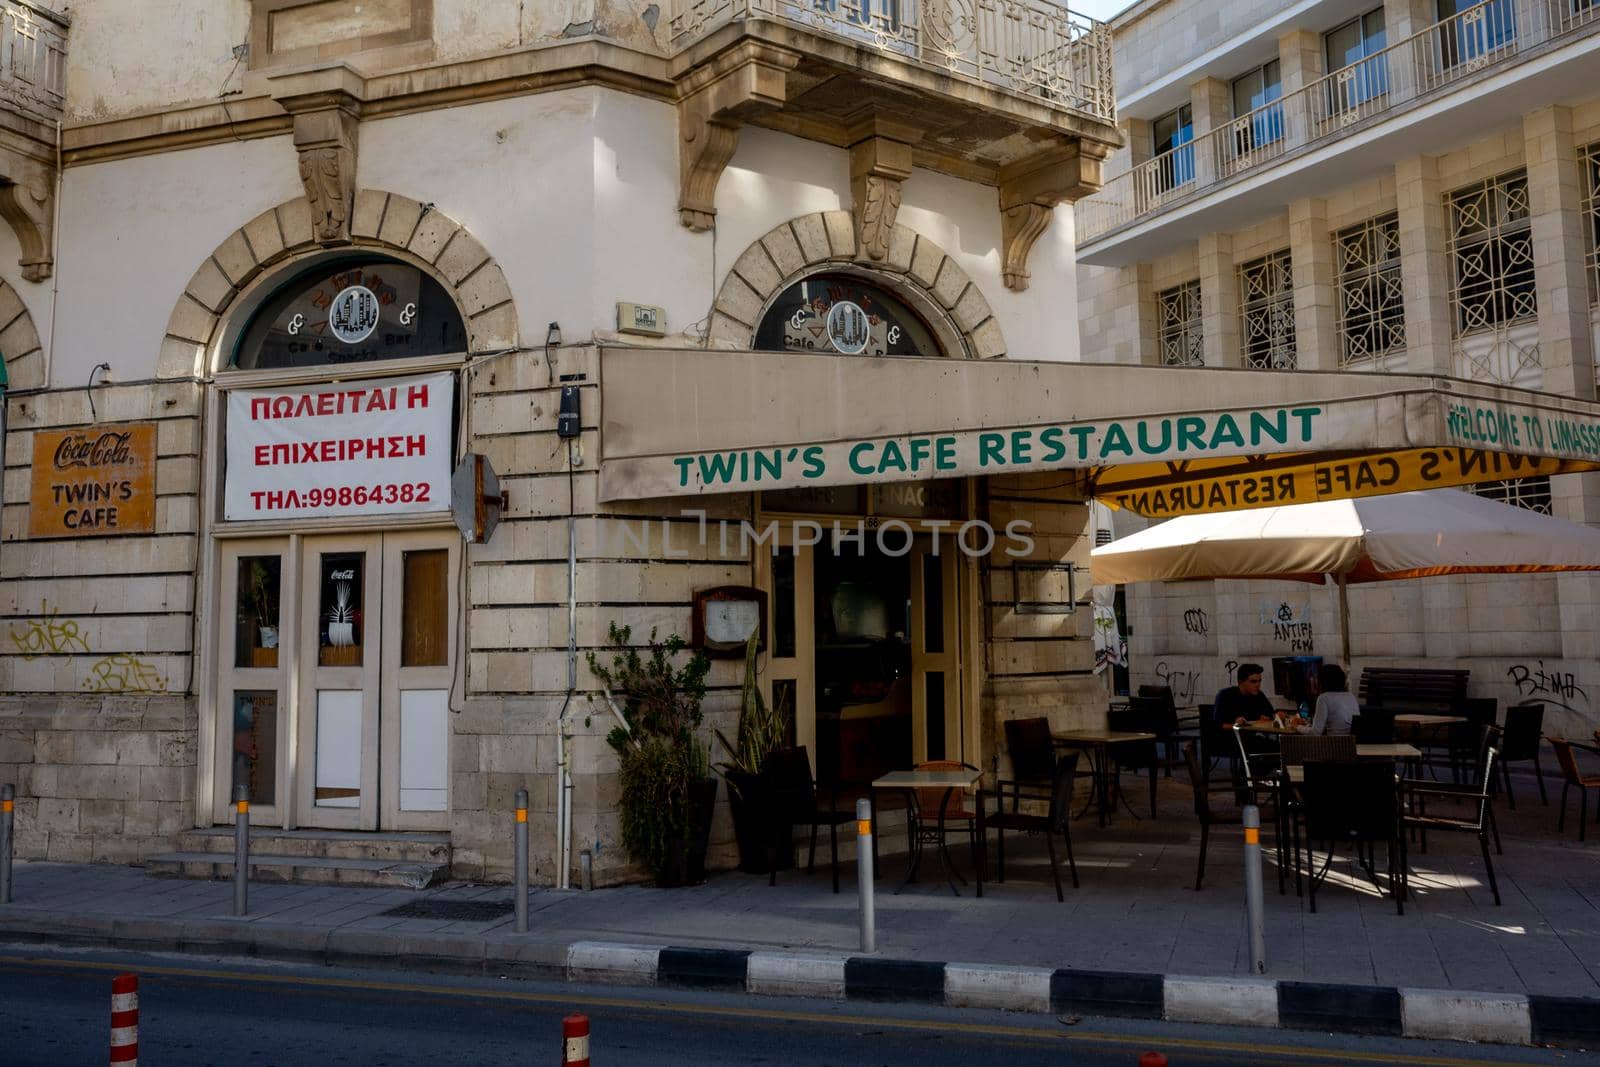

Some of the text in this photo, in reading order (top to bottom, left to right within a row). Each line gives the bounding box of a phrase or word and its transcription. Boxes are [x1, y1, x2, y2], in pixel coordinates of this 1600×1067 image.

[288, 340, 324, 353] Cae
[783, 334, 815, 350] Cafe
[251, 384, 429, 420] ΠΩΛΕΙΤΑΙ Η
[1447, 404, 1520, 446] WELCOME
[1522, 415, 1544, 448] TO
[254, 434, 426, 466] ΕΠΙΧΕΙΡΗΣΗ
[673, 407, 1322, 487] TWIN'S CAFE RESTAURANT
[52, 481, 132, 504] TWIN'S
[251, 482, 430, 511] ΤΗΛ:99864382
[63, 507, 118, 529] CAFE
